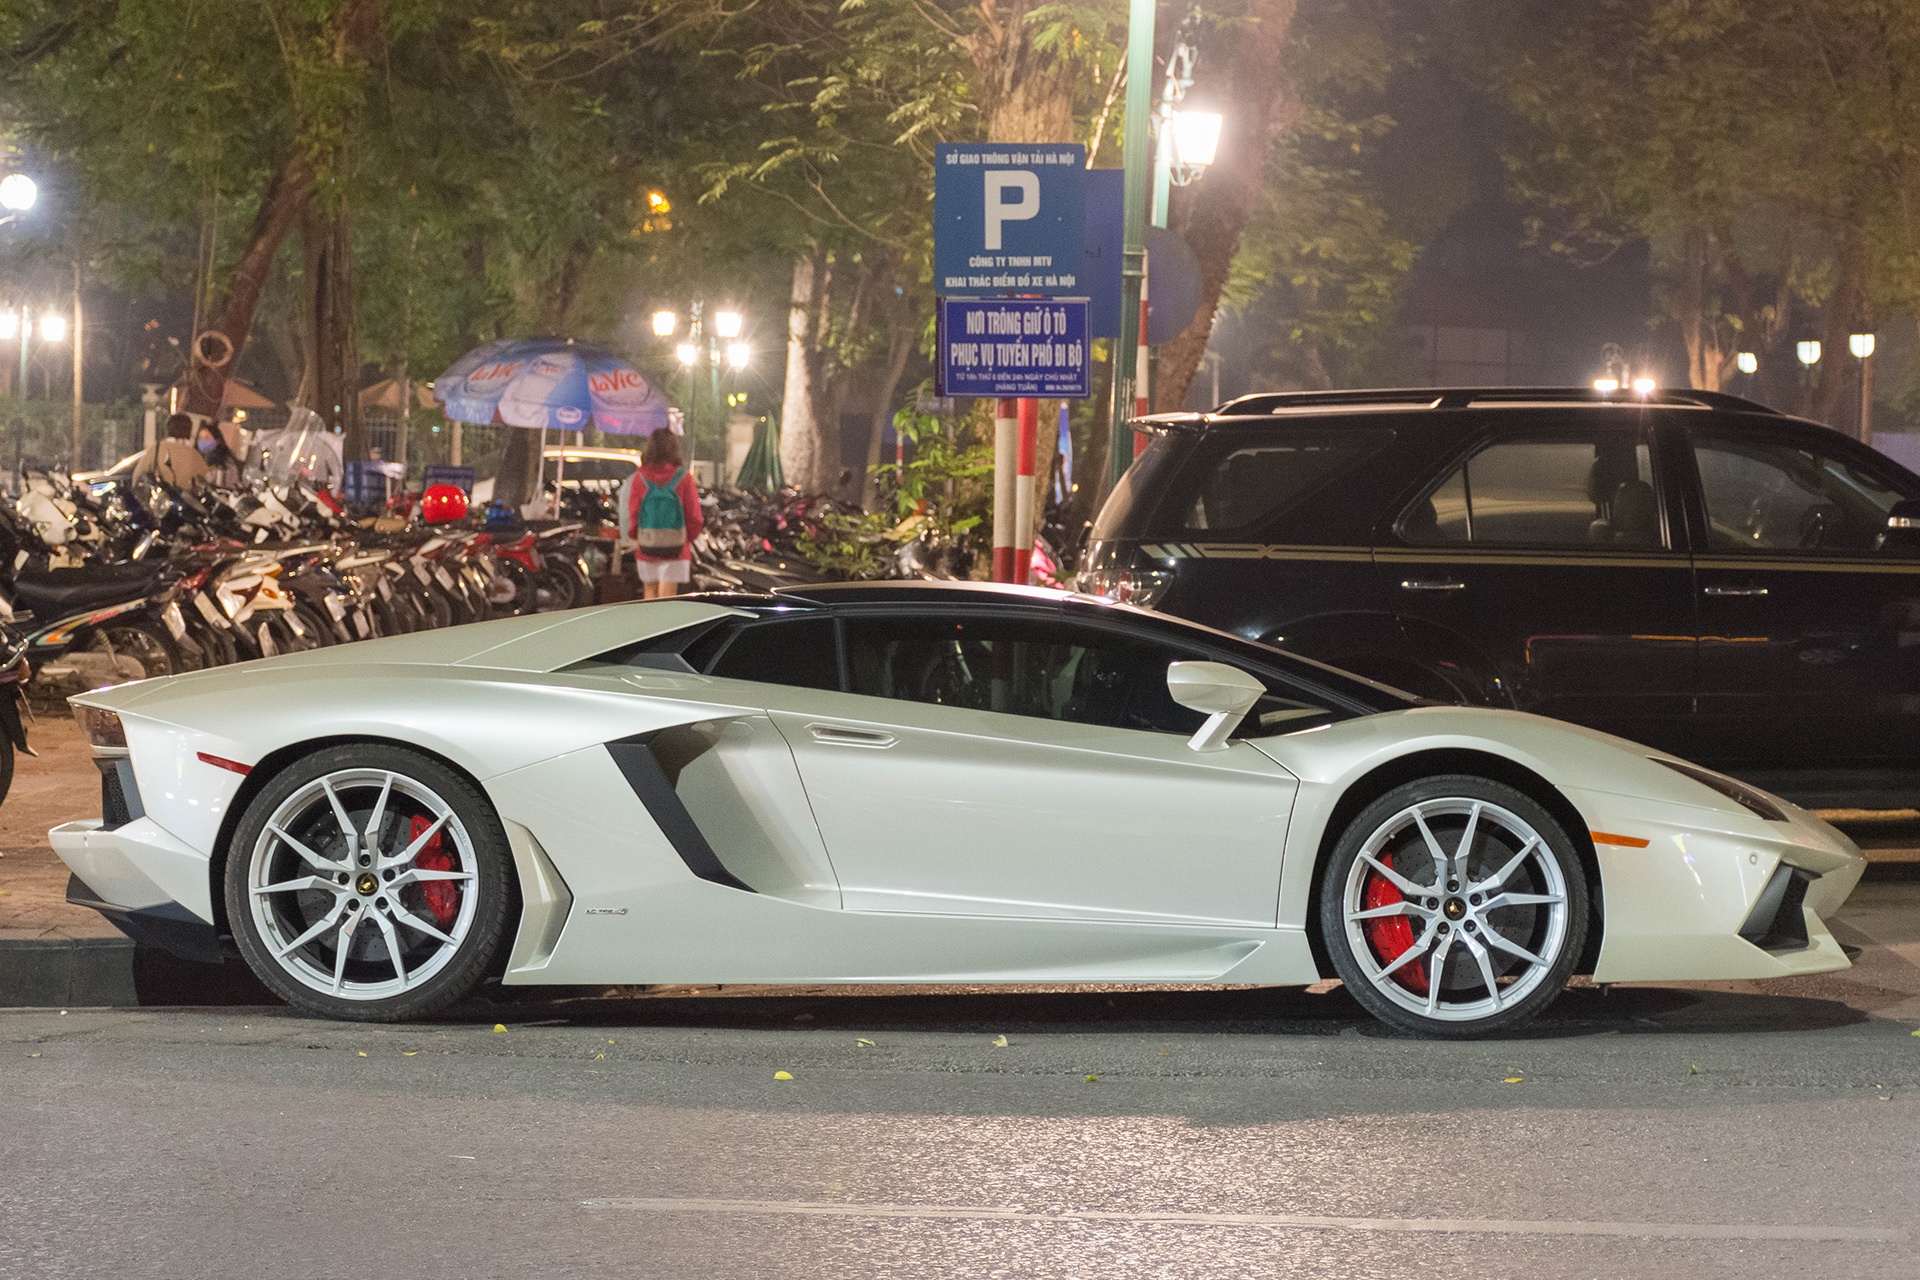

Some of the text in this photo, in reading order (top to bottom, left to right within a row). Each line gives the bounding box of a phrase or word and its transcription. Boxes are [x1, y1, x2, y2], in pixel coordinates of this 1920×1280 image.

[959, 154, 980, 165] GIAO
[981, 151, 1009, 165] THÔNG
[1011, 151, 1029, 166] VẬN
[1045, 151, 1057, 165] HÀ
[1059, 151, 1074, 166] NỘI
[985, 170, 1040, 249] P
[969, 255, 1052, 267] CÔNG TY TNHH MTV
[945, 276, 966, 288] KHAI
[968, 274, 991, 287] THÁC
[992, 271, 1016, 287] ĐIỂM
[1032, 275, 1043, 287] XE
[1045, 273, 1058, 287] HÀ
[1059, 273, 1075, 288] NỘI
[966, 310, 985, 334] NƠI
[987, 307, 1021, 334] TRÔNG
[1043, 306, 1051, 335] Ô
[1053, 306, 1066, 334] TÔ
[951, 336, 1083, 372] PHỤC VỤ TUYẾN PHỐ ĐI BỘ
